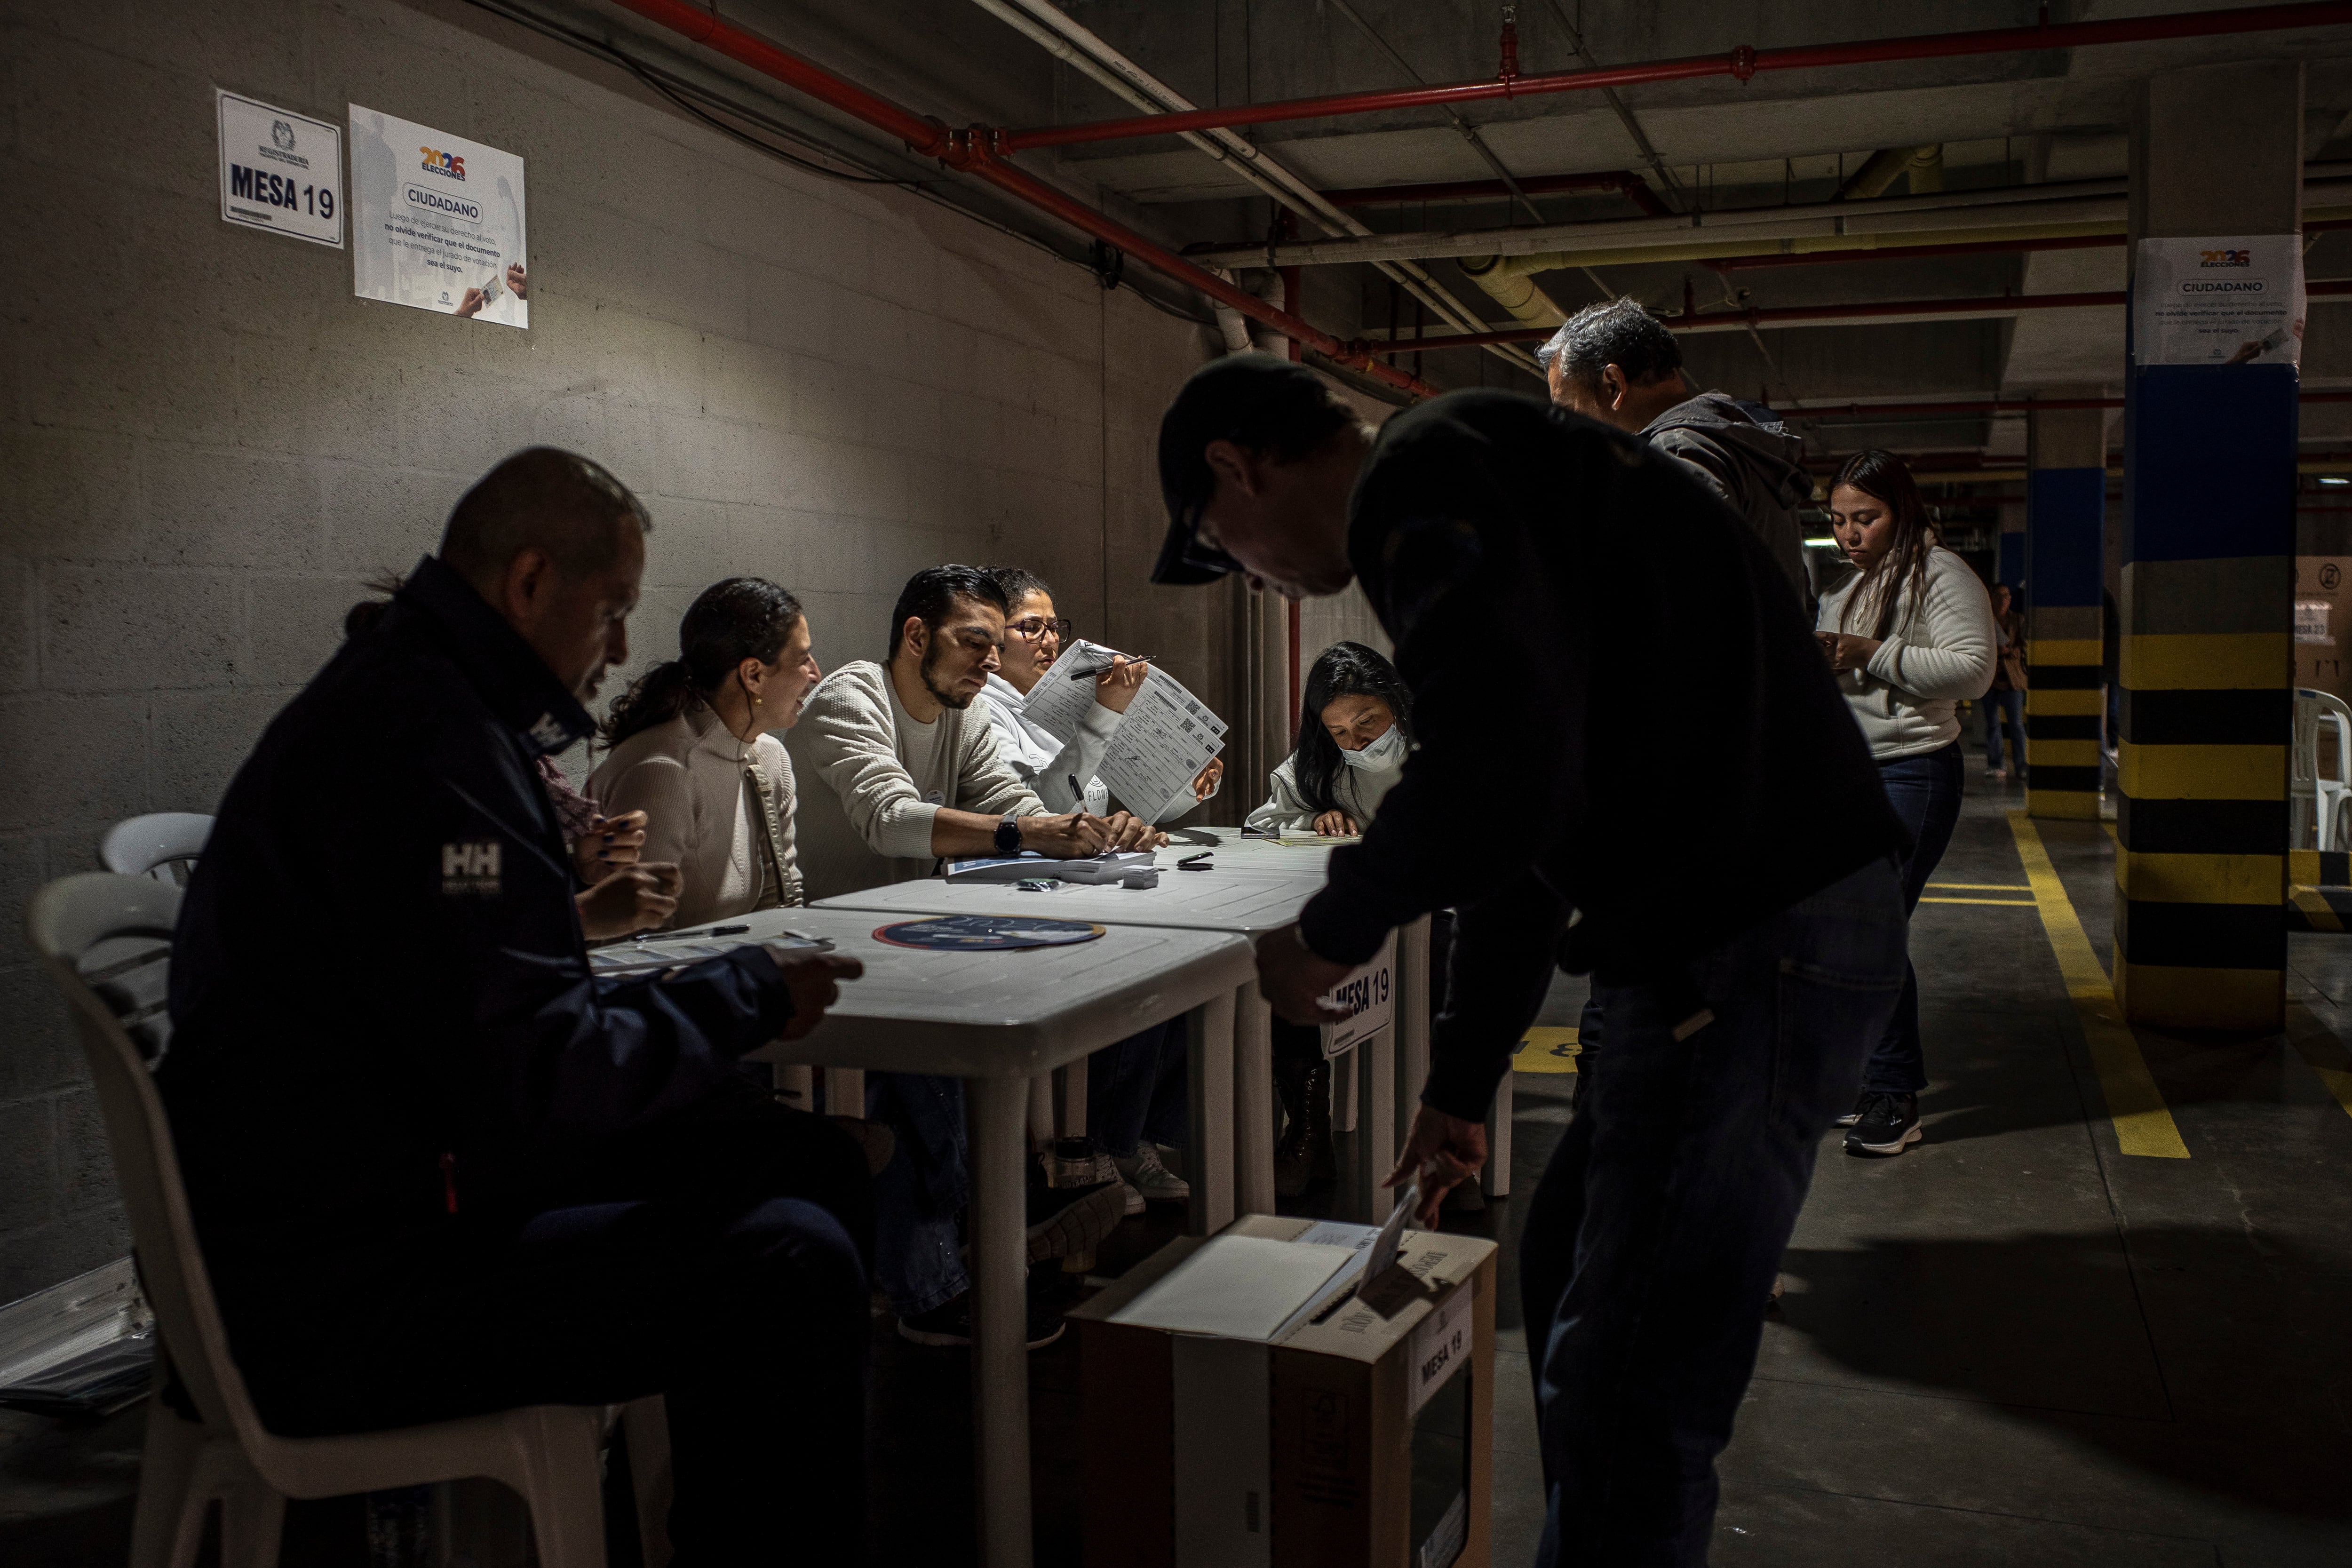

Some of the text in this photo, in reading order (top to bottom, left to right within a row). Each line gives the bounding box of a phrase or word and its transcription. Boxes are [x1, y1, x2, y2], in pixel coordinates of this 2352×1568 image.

[419, 146, 465, 176] 2026
[422, 162, 465, 182] ELECCIONES
[231, 163, 334, 219] MESA 19
[408, 189, 478, 218] CIUDADANO
[389, 211, 409, 223] Luego
[420, 219, 441, 230] ejercer
[450, 227, 475, 239] derecho
[389, 237, 402, 246] que
[403, 239, 409, 248] le
[411, 242, 435, 255] entrega
[436, 247, 441, 256] el
[442, 249, 462, 261] jurado
[472, 258, 497, 269] votación
[396, 225, 416, 237] olvide
[417, 231, 443, 243] verificar
[445, 239, 457, 248] que
[466, 243, 500, 258] documento
[2200, 250, 2250, 263] 2026
[446, 264, 463, 273] suyo.
[2183, 283, 2263, 292] CIUDADANO
[441, 843, 502, 877] HH
[1336, 968, 1388, 1024] MESA 19
[1422, 1330, 1462, 1386] MESA 19
